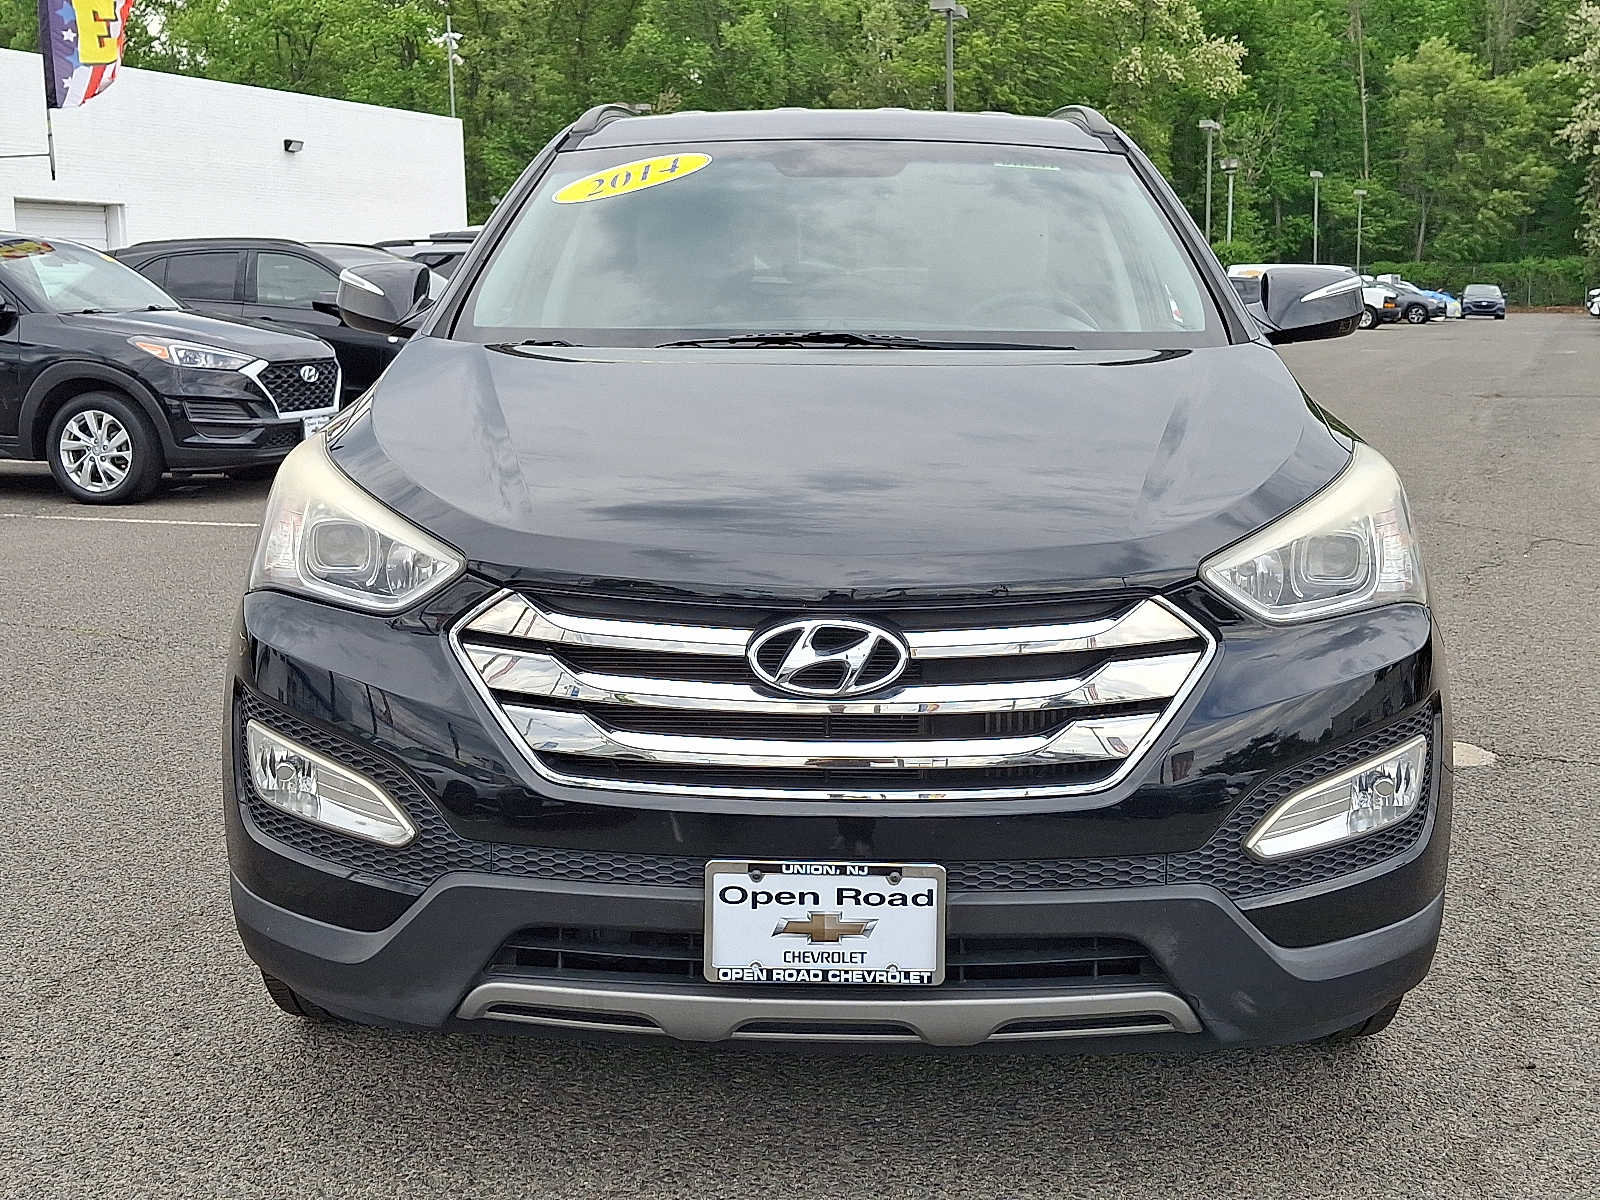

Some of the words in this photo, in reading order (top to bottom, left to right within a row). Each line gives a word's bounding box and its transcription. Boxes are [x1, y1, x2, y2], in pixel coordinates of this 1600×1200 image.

[586, 157, 680, 197] 2014
[781, 864, 840, 875] UNION,
[846, 865, 869, 875] NJ
[719, 886, 820, 909] Open
[836, 888, 934, 907] Road
[783, 951, 867, 964] CHEVROLET
[718, 968, 767, 982] OPEN
[772, 969, 823, 982] ROAD
[827, 970, 932, 984] CHEVROLET
